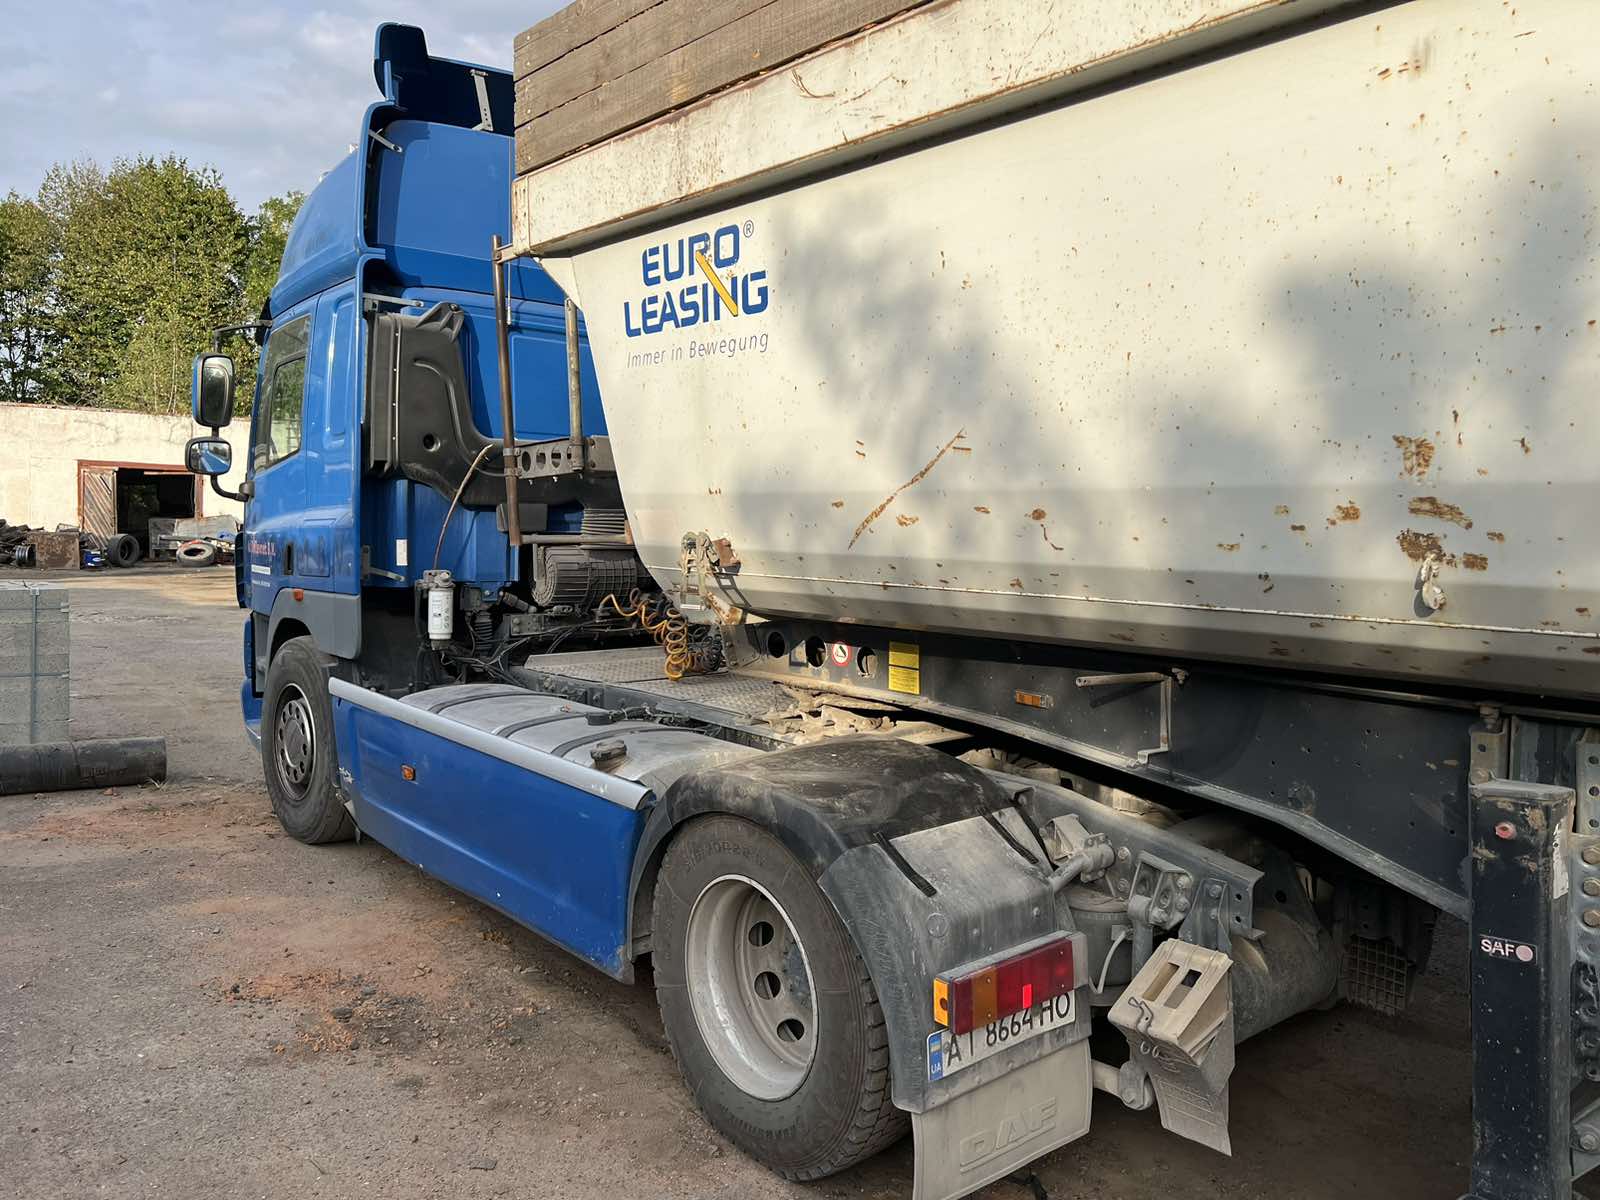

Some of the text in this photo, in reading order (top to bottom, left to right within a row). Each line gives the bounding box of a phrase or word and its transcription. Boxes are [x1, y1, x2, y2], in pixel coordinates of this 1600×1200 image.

[623, 270, 769, 338] LEASING
[626, 332, 769, 368] Immer in Bewegung
[985, 1006, 1034, 1047] 8664
[930, 1064, 942, 1074] UA
